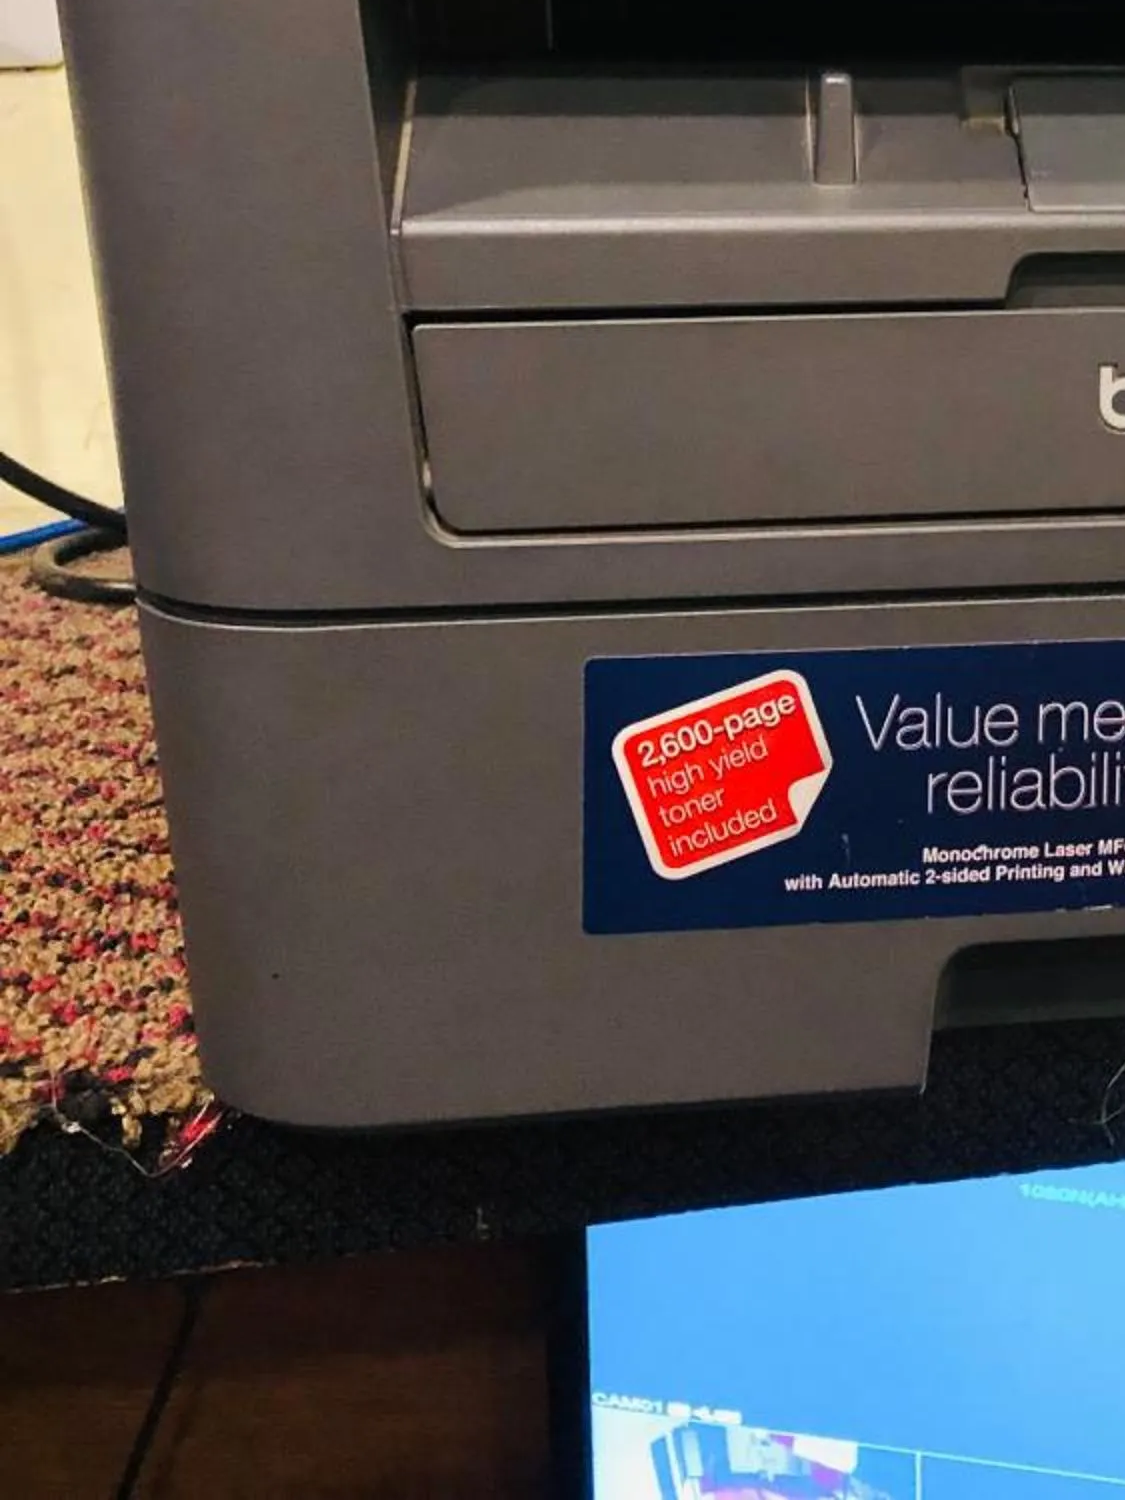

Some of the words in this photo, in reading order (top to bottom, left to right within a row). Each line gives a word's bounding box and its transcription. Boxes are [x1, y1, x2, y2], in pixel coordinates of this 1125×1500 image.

[636, 694, 797, 769] 2,600-page
[855, 692, 1019, 750] Value
[647, 762, 704, 799] high
[710, 734, 769, 780] yield
[659, 787, 725, 828] toner
[668, 798, 778, 857] included
[784, 874, 823, 891] with
[828, 870, 920, 889] Automatic
[925, 865, 990, 885] 2-sided
[996, 862, 1065, 882] Printing
[1070, 861, 1103, 878] and
[923, 844, 1039, 864] Monochrome
[1044, 841, 1093, 858] Laser
